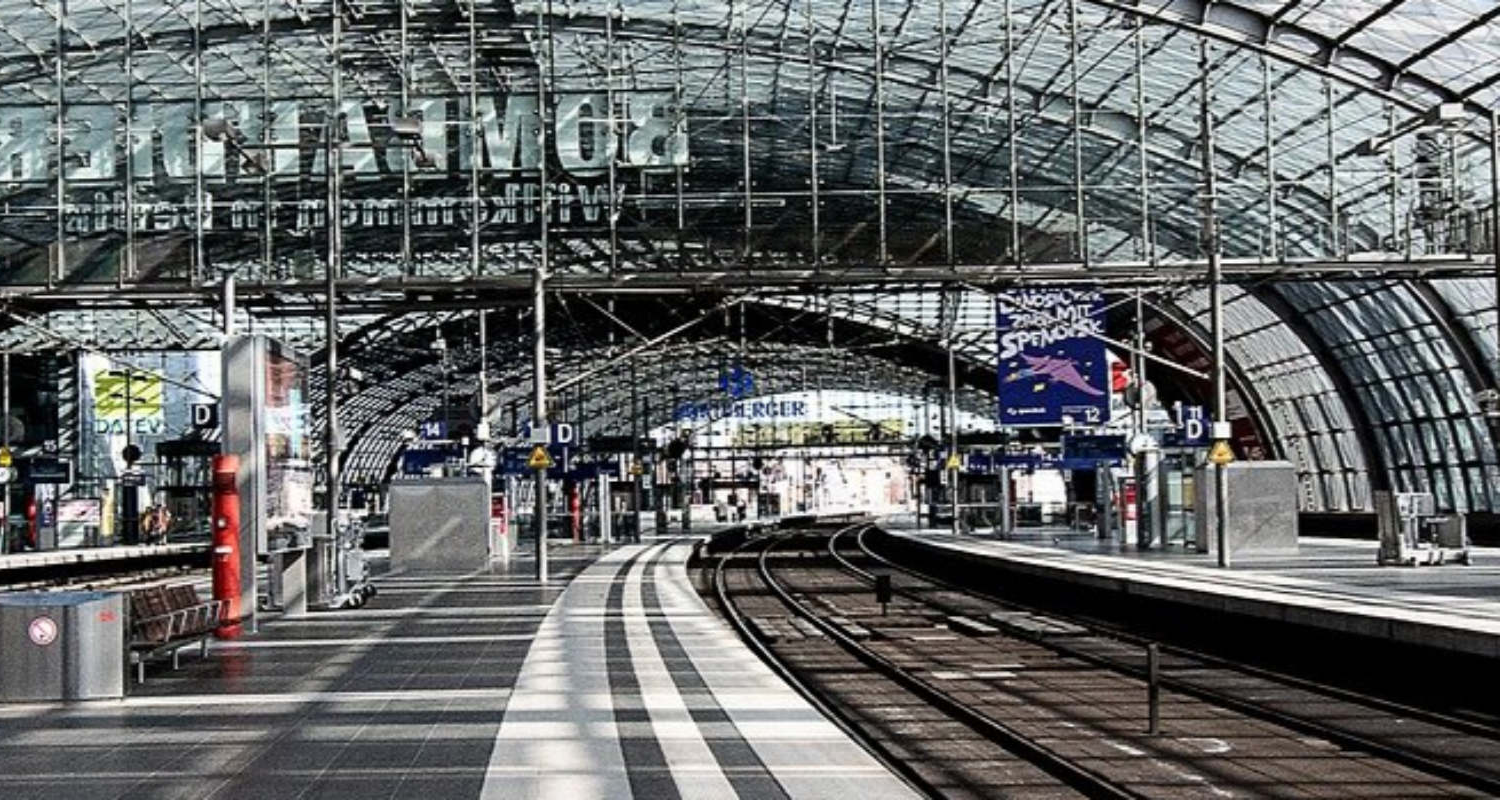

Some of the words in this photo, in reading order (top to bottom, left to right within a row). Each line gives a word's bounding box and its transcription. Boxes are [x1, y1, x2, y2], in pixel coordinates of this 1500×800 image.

[195, 406, 210, 425] D
[1085, 408, 1100, 422] 12
[97, 419, 160, 433] DAEV
[558, 423, 572, 443] D
[1187, 419, 1203, 438] D
